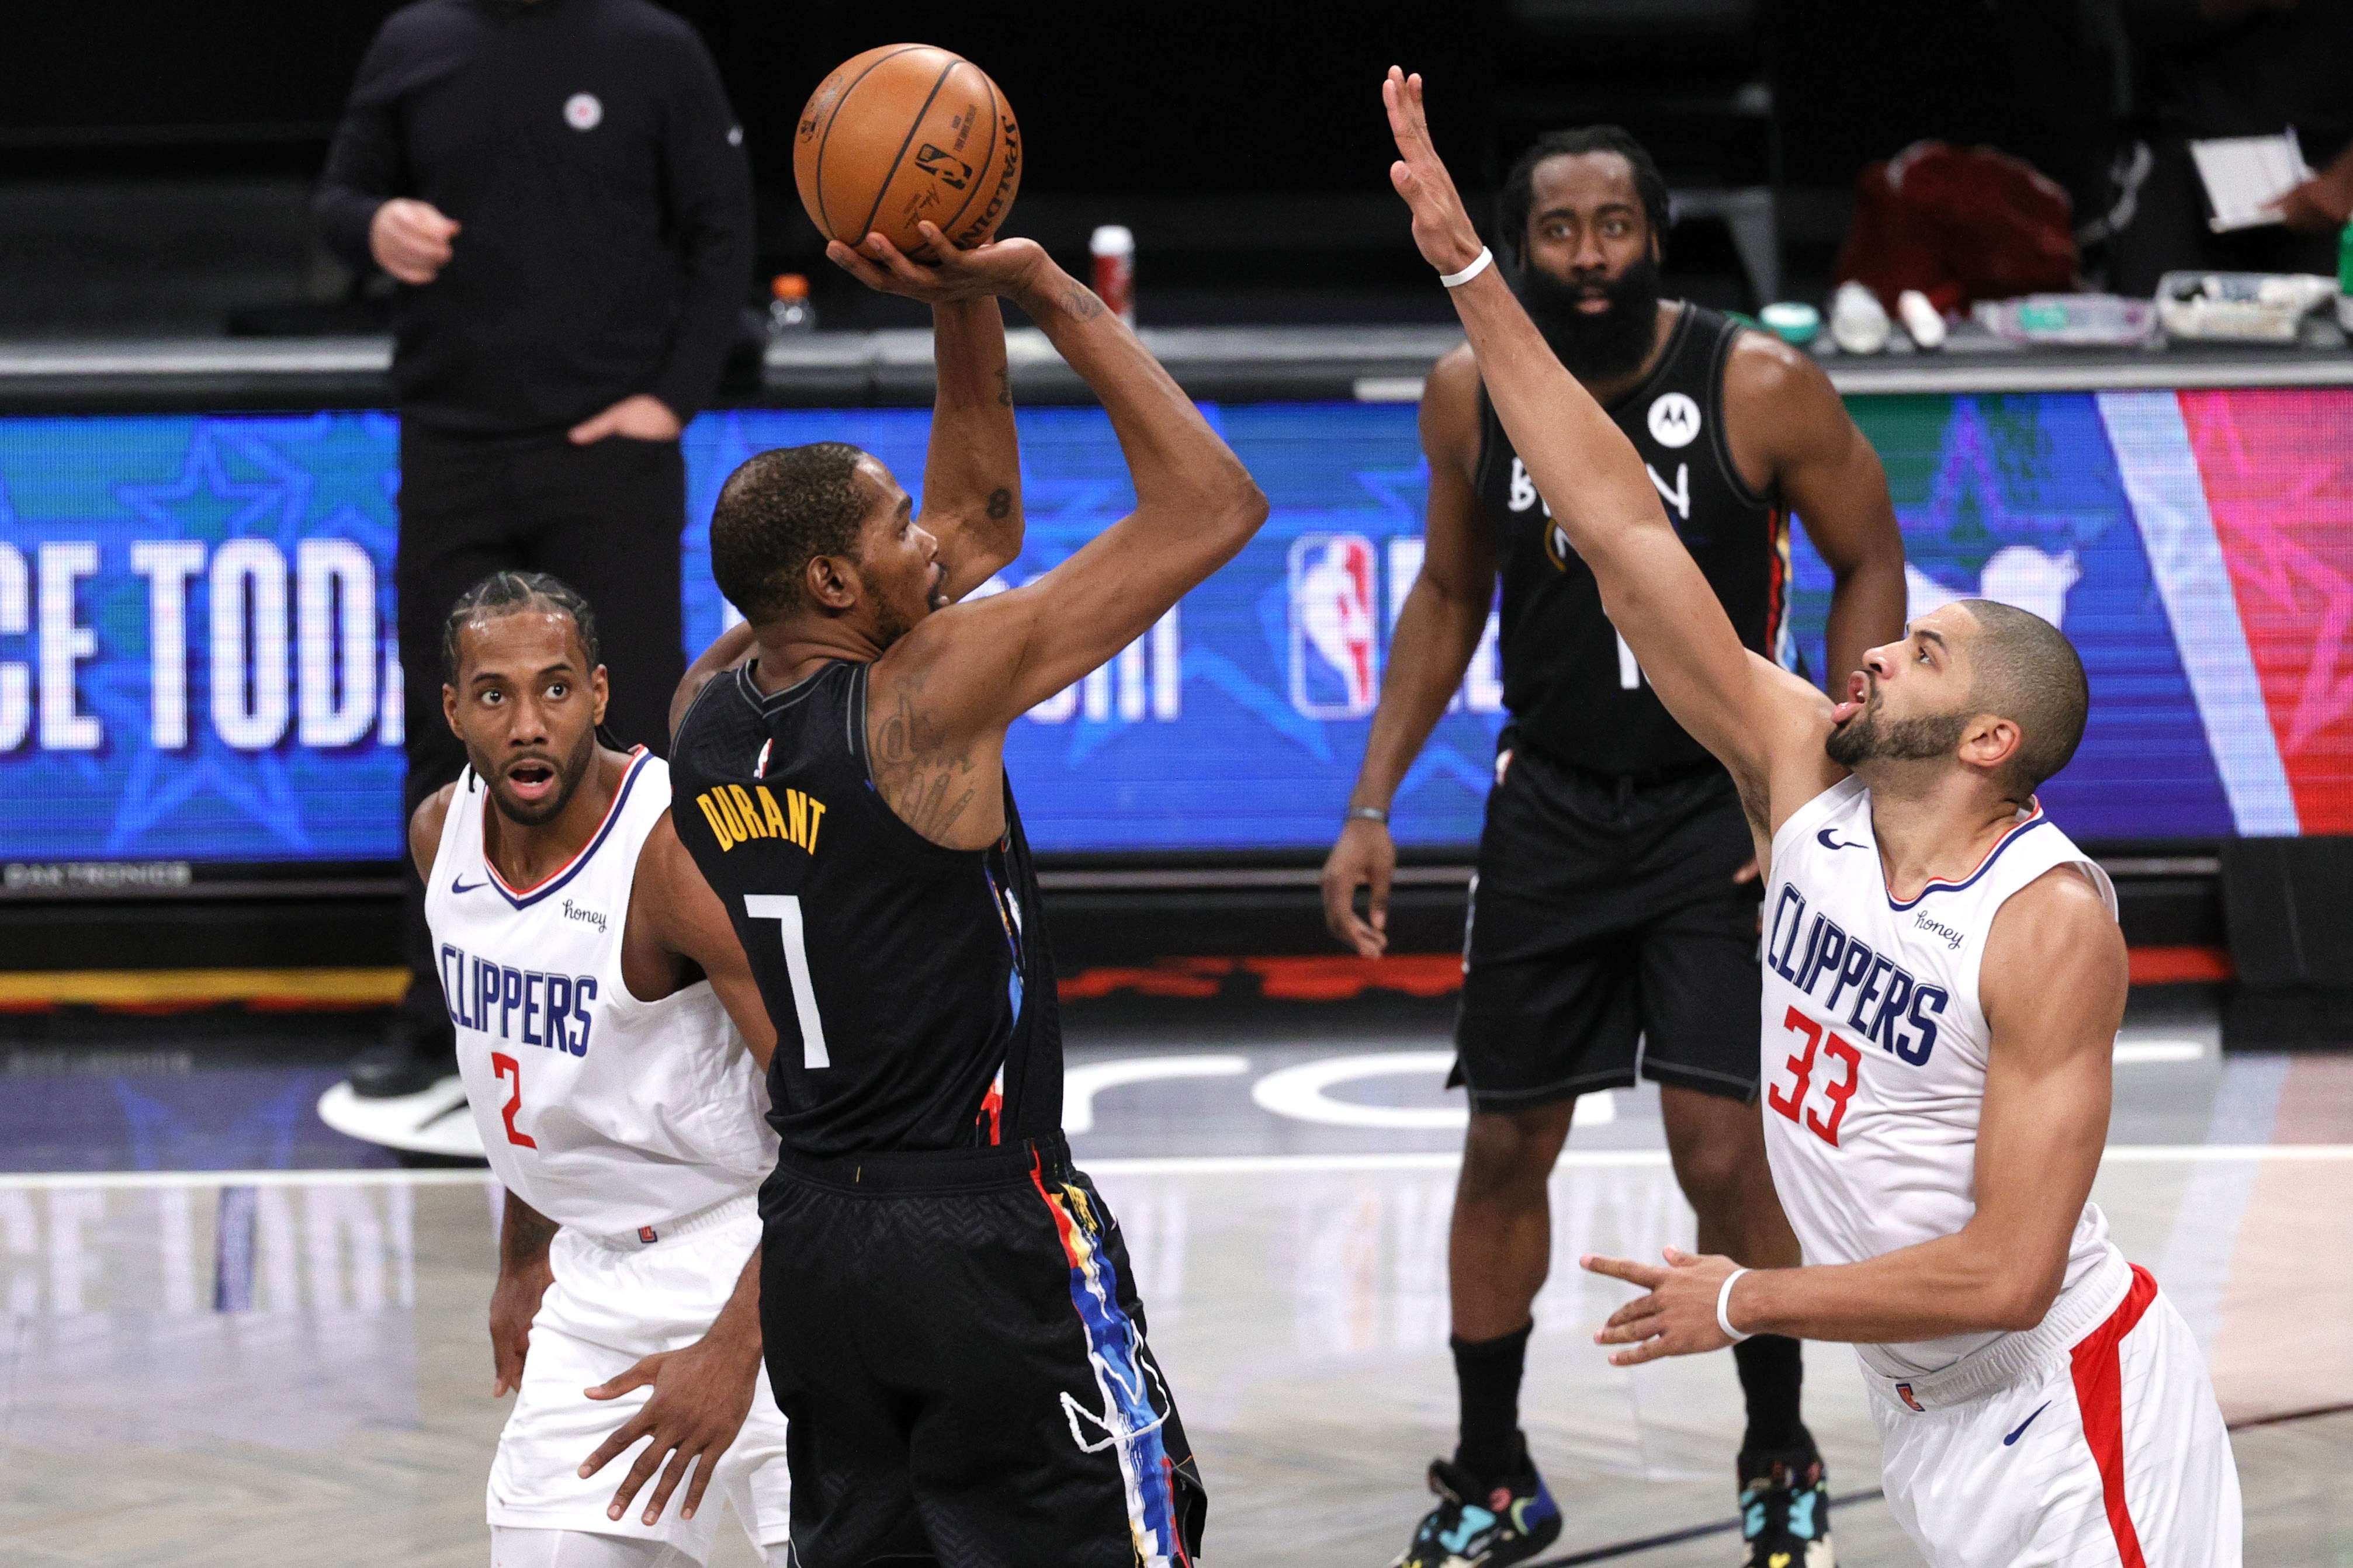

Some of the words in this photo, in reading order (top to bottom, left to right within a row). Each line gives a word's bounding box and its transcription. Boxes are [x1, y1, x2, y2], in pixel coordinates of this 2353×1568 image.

[696, 784, 826, 856] DURANT
[563, 900, 607, 932] honey
[1914, 910, 1964, 949] honey
[441, 942, 598, 1057] CLIPPERS
[743, 894, 830, 1069] 7
[1767, 882, 1948, 1067] CLIPPERS
[491, 1052, 538, 1149] 2
[1768, 1004, 1863, 1147] 33
